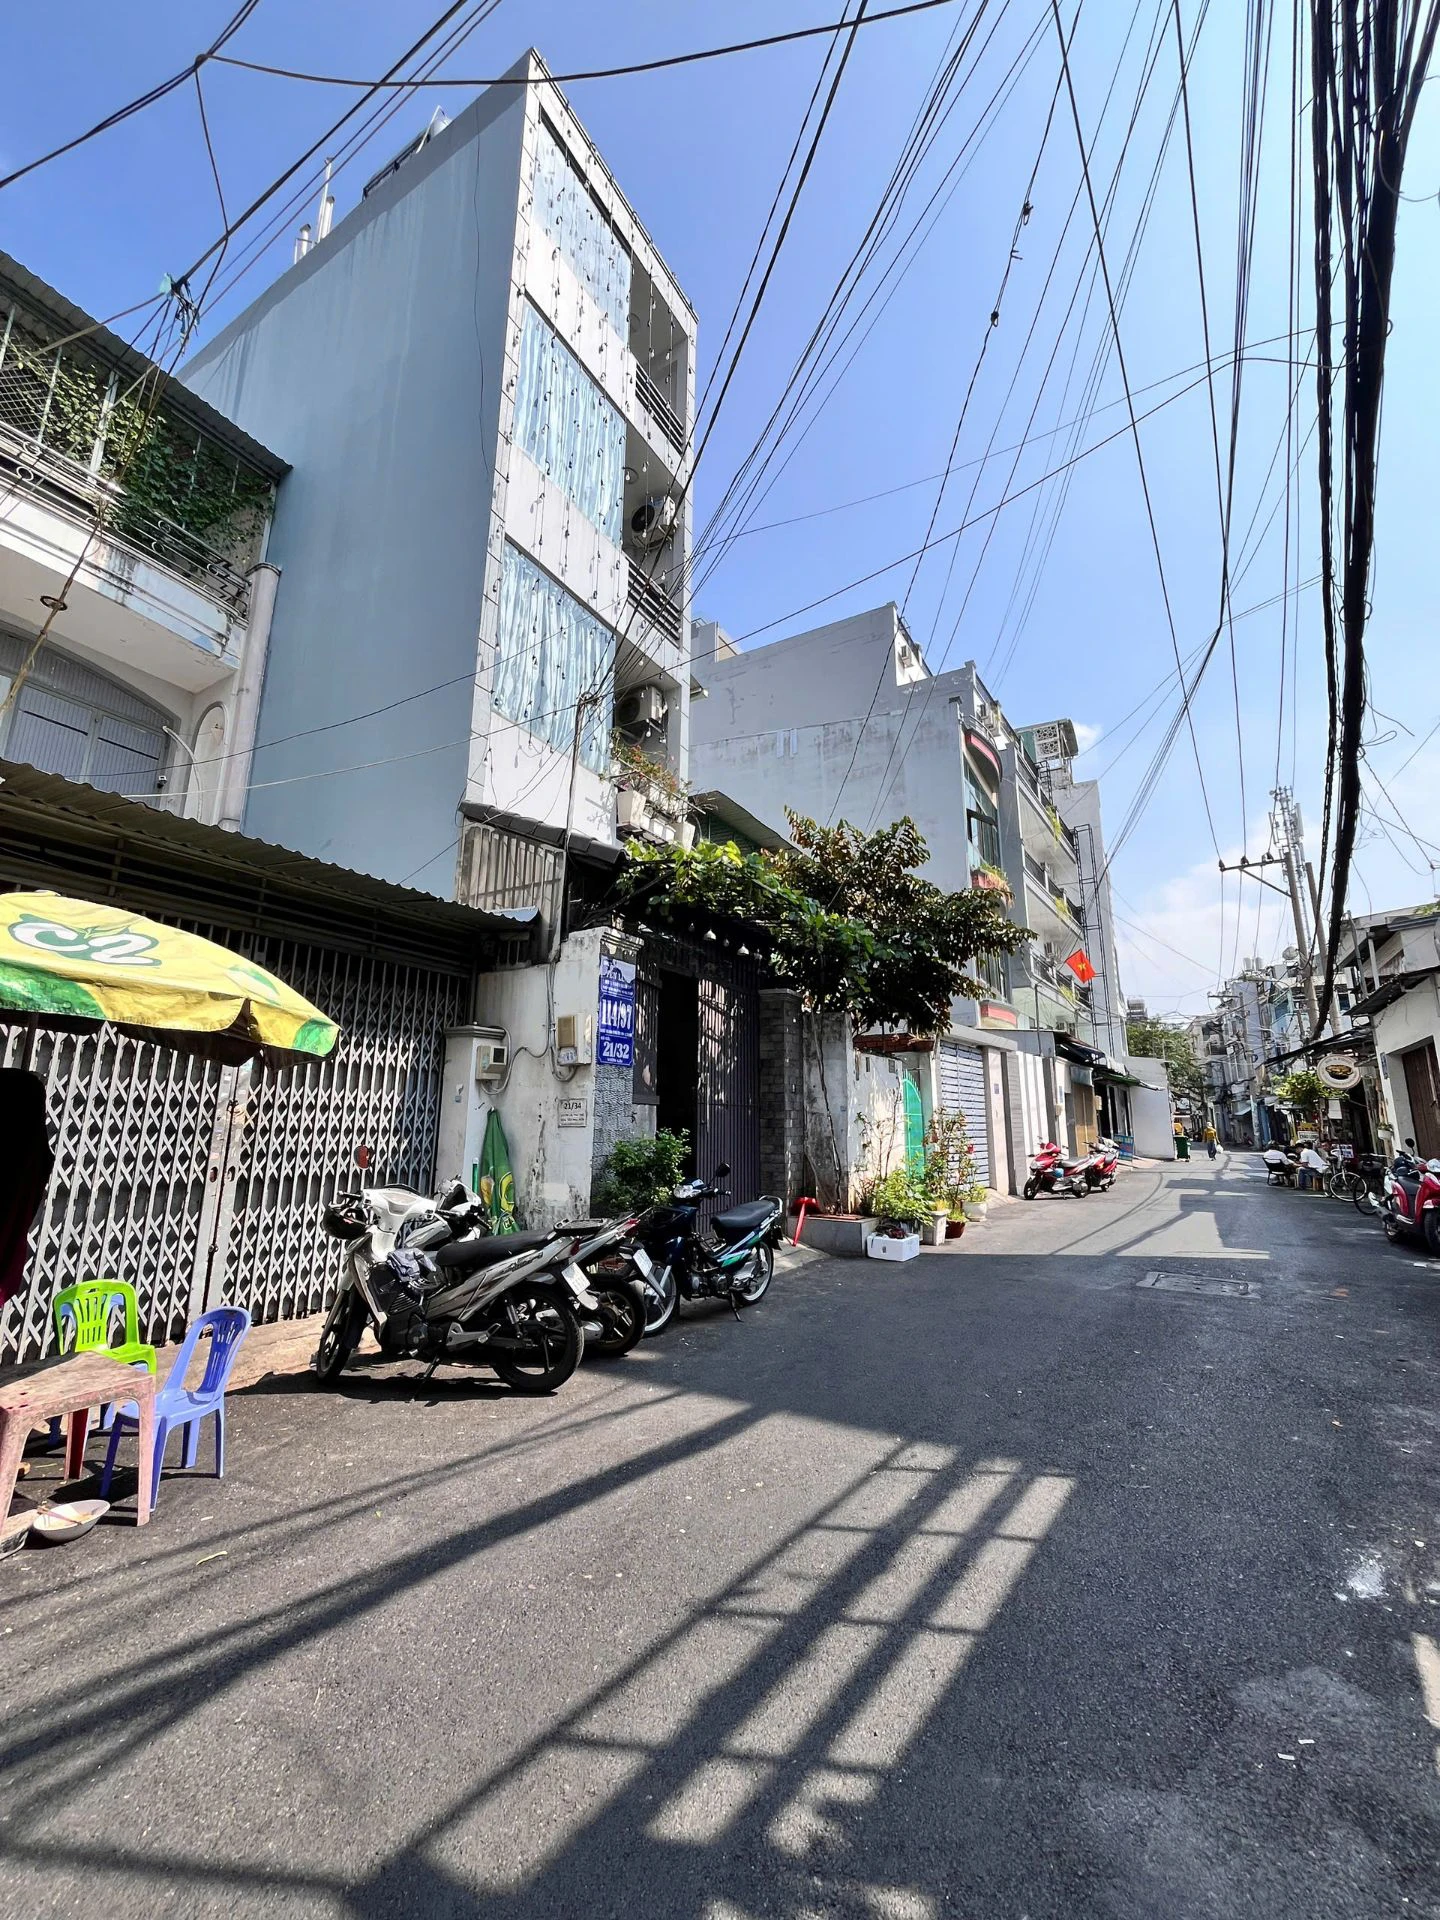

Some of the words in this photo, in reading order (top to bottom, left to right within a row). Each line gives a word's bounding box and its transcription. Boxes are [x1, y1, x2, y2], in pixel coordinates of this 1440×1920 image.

[9, 914, 161, 966] C2
[601, 999, 633, 1030] 114/97
[602, 1041, 630, 1059] 21/32
[564, 1102, 582, 1110] 21/34
